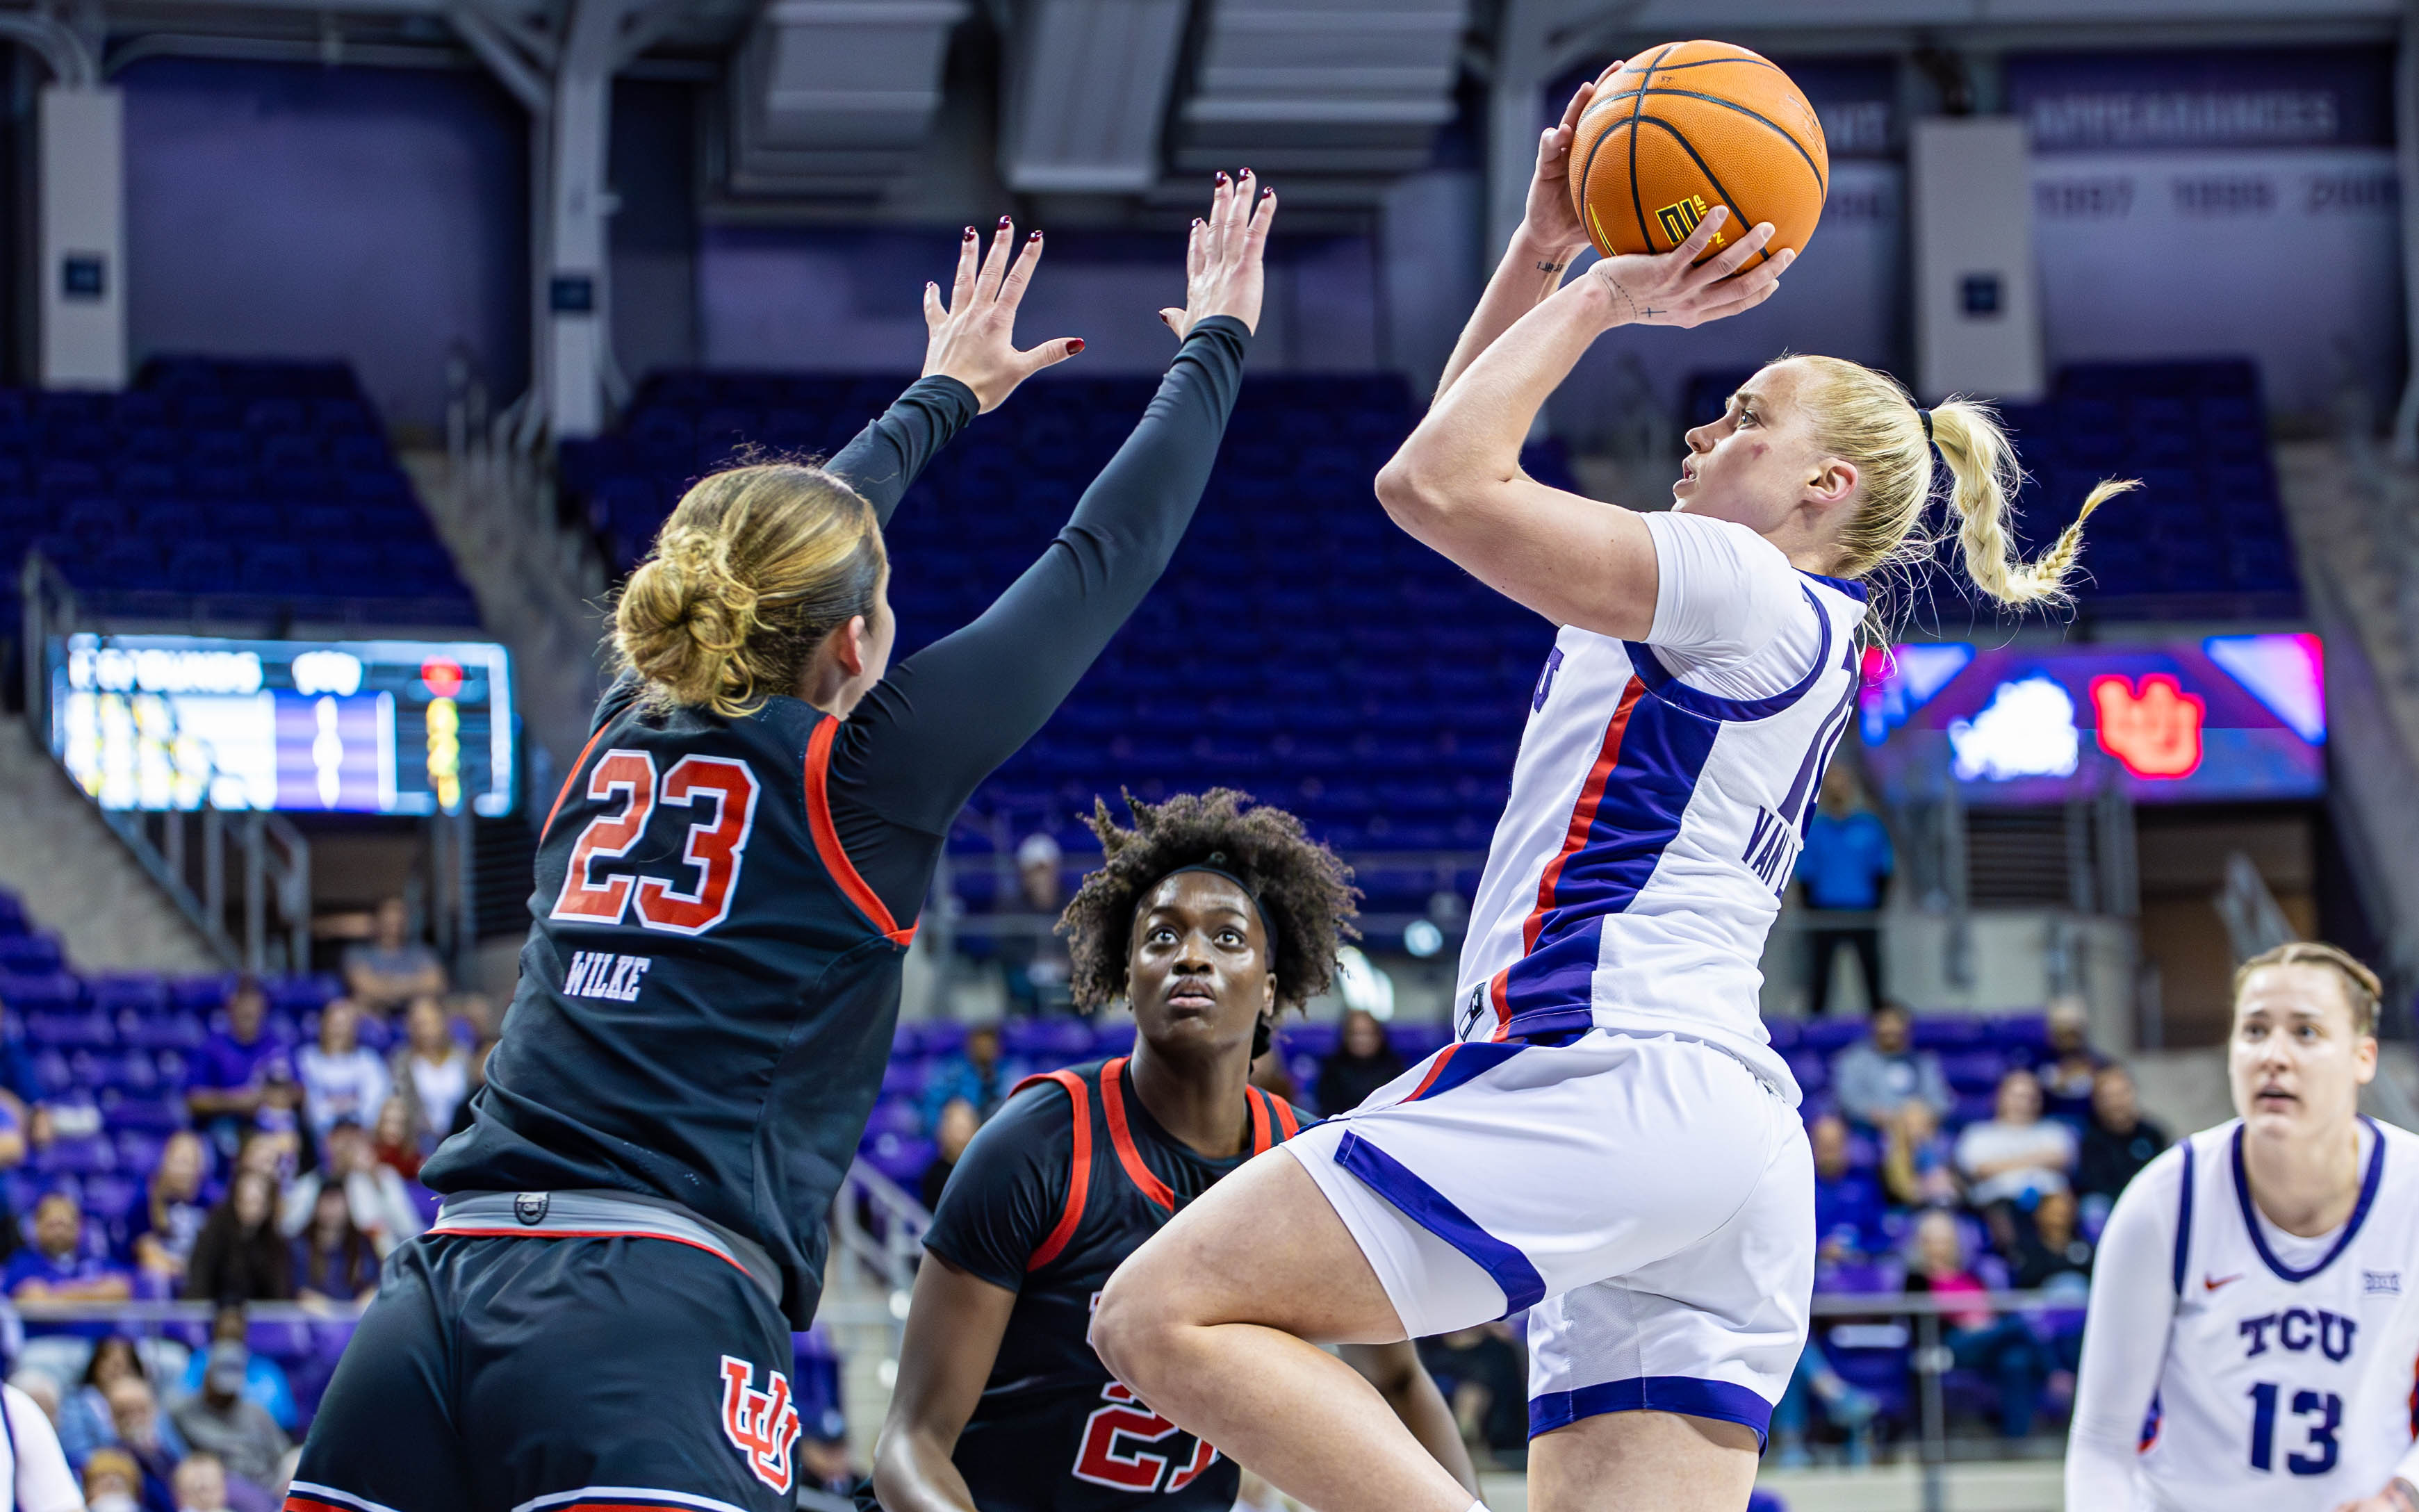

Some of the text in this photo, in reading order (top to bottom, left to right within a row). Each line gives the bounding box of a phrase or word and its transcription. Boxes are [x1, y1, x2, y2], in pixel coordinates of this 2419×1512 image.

[549, 748, 761, 937] 23
[1741, 805, 1790, 887] VAN
[563, 950, 652, 1003] WILKE
[2240, 1307, 2359, 1363] TCU
[1072, 1380, 1219, 1493] 2
[2248, 1382, 2343, 1476] 13
